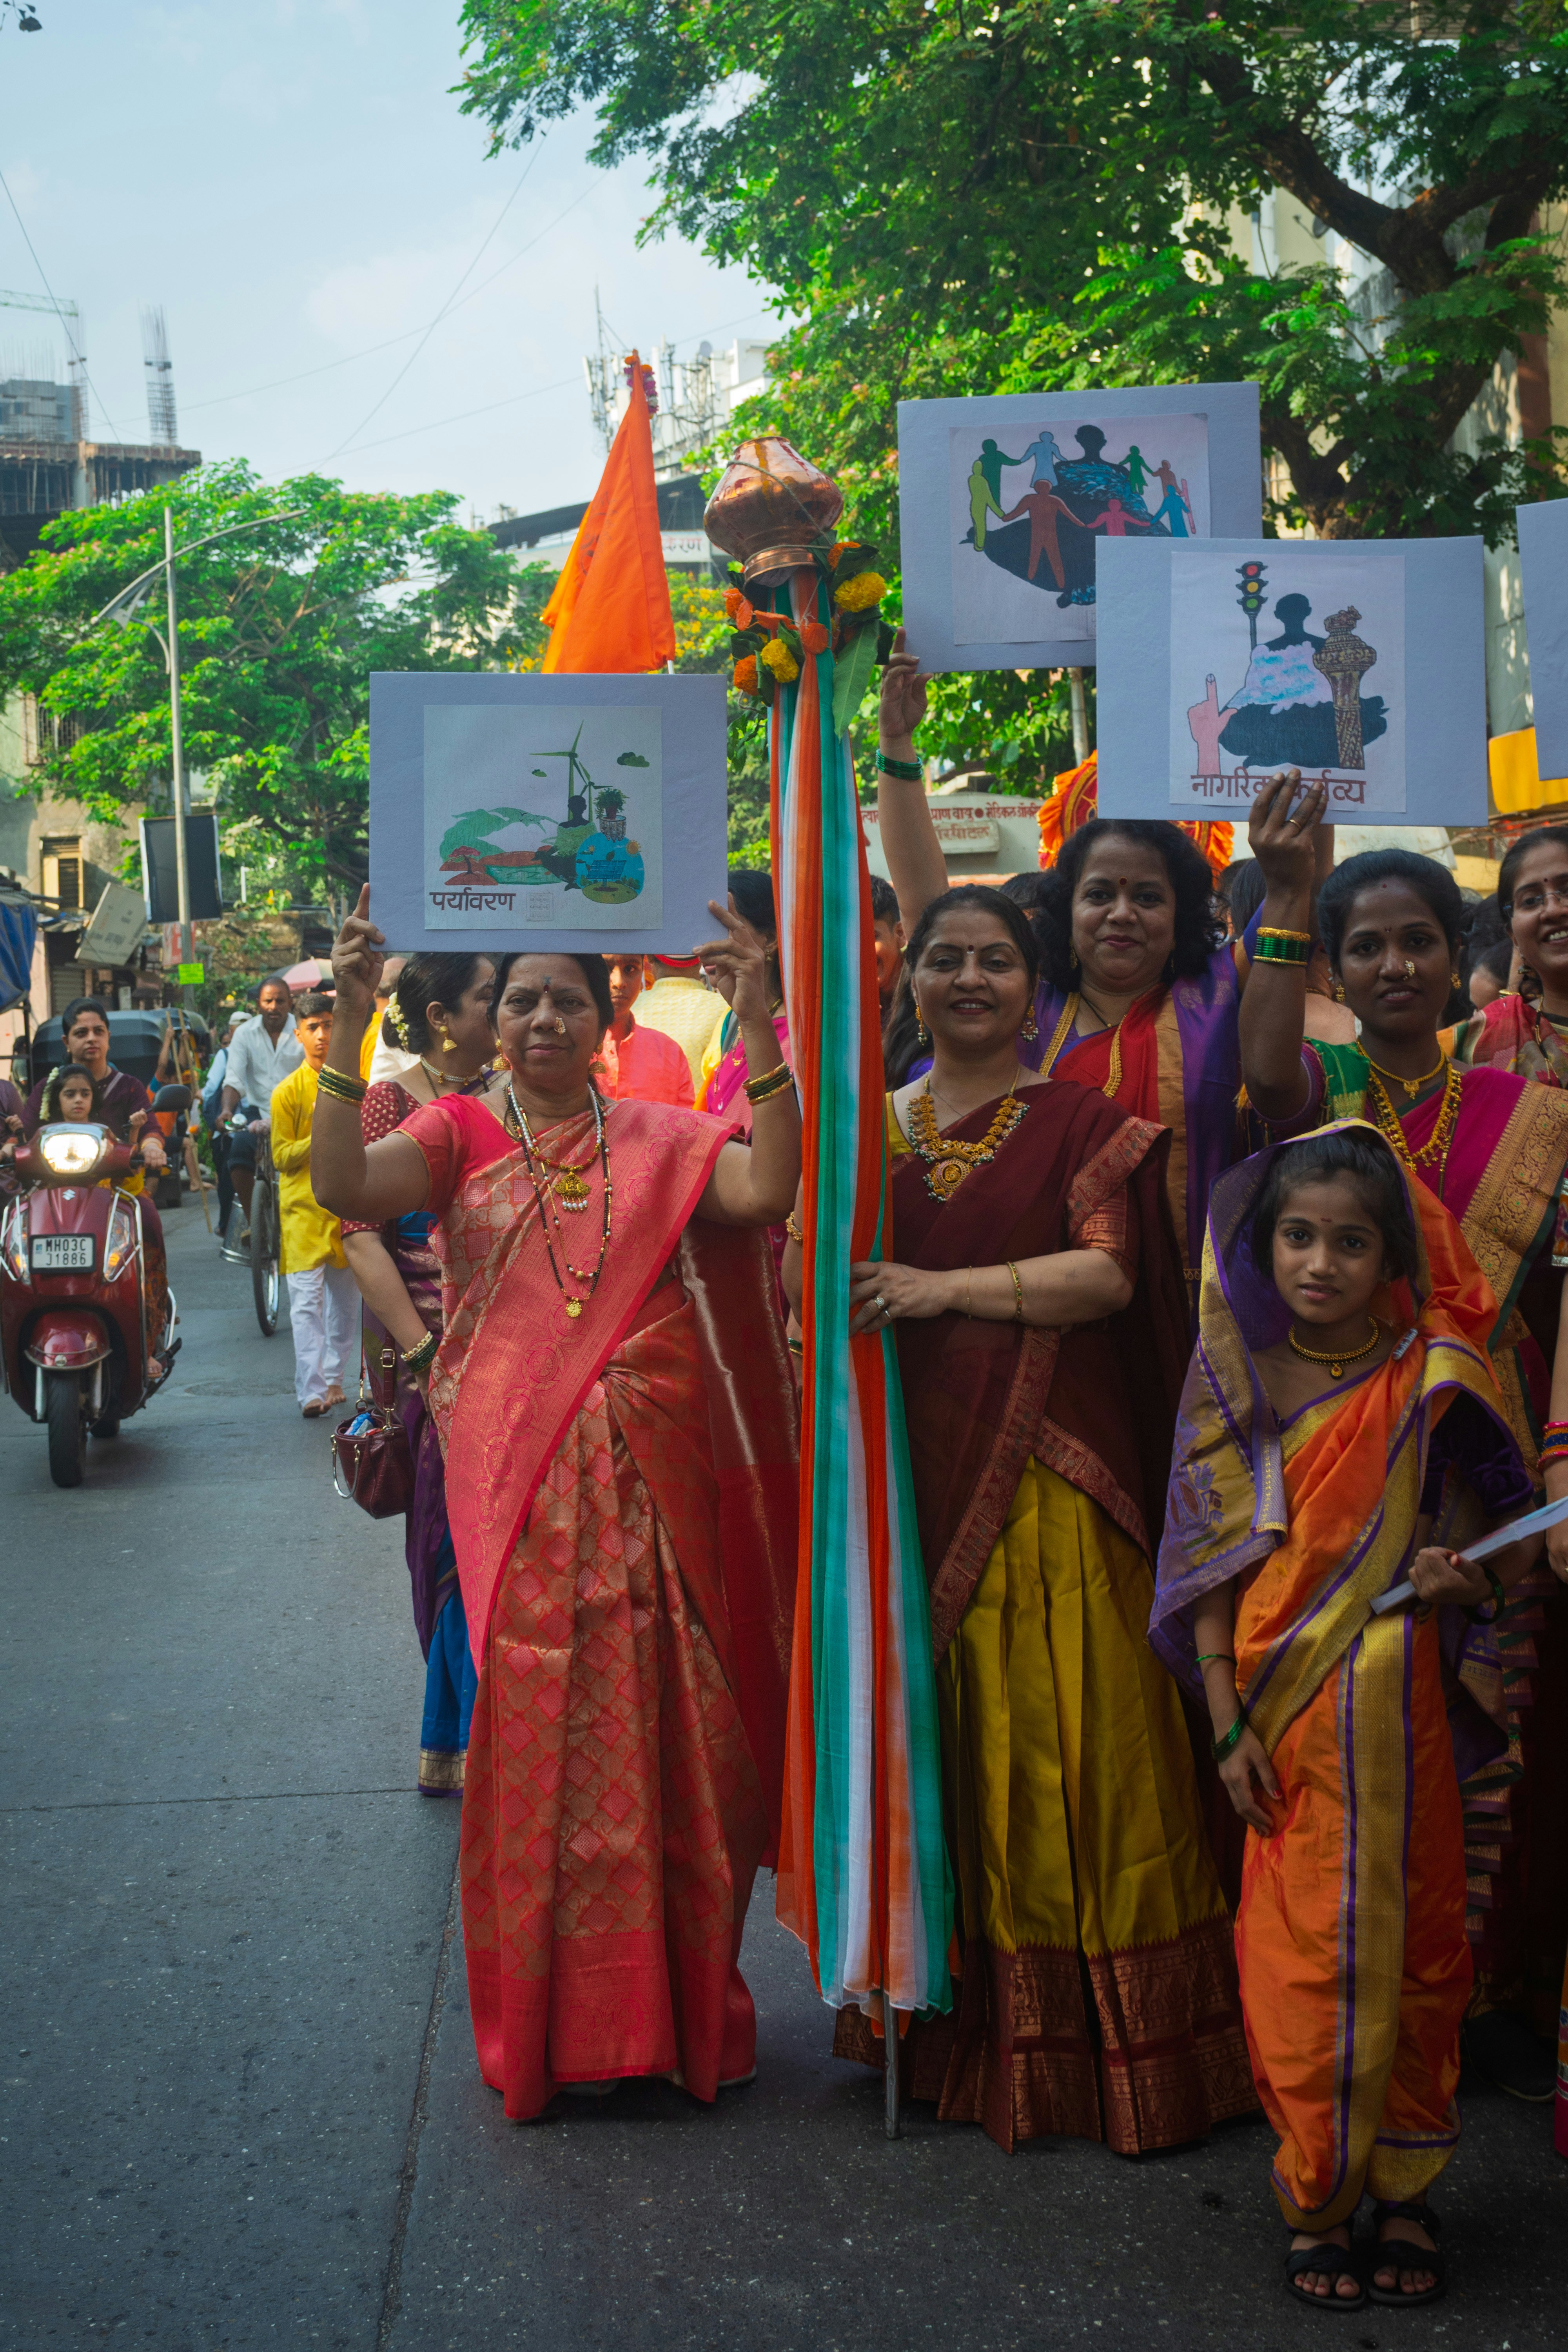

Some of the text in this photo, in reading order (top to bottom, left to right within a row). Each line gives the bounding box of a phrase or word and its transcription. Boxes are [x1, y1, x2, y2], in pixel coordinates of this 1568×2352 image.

[430, 887, 516, 911] पर्यावरण
[46, 1239, 86, 1252] MH03C
[46, 1252, 86, 1265] J1886
